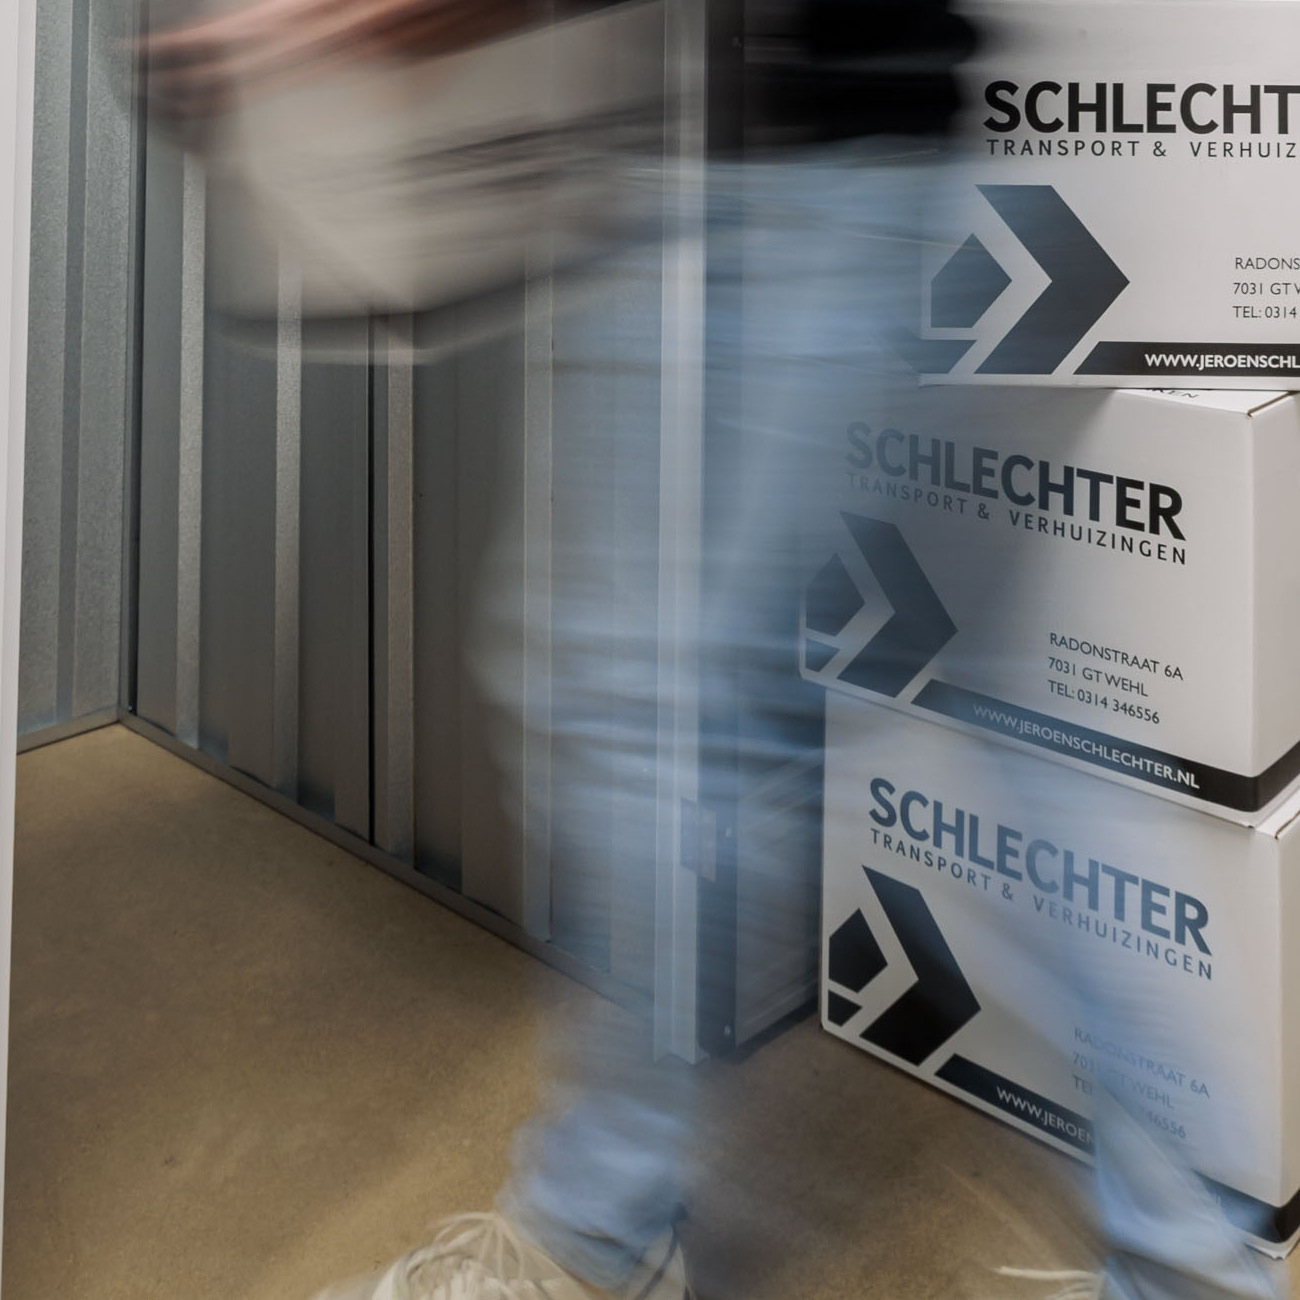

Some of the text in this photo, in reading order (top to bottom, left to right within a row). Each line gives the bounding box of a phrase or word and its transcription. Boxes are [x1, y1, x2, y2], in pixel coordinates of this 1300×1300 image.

[986, 138, 1139, 155] TRANSPORT
[1153, 140, 1166, 156] &
[1233, 281, 1262, 294] 7031
[1269, 282, 1291, 295] GT
[1265, 305, 1296, 318] 0314
[845, 421, 1186, 540] SCHLECHTER
[847, 472, 1185, 564] TRANSPORT & VERHUIZINGEN
[1049, 656, 1147, 697] 7031 GT WEHL
[1050, 632, 1182, 680] RADONSTRAAT 6A
[1078, 689, 1107, 708] 0314
[1113, 699, 1159, 724] 346556
[972, 704, 1199, 789] WWW.JEROENSCHLECHTER.NL
[868, 777, 1211, 955] SCHLECHTER
[869, 827, 1211, 980] TRANSPORT & VERHUIZINGEN
